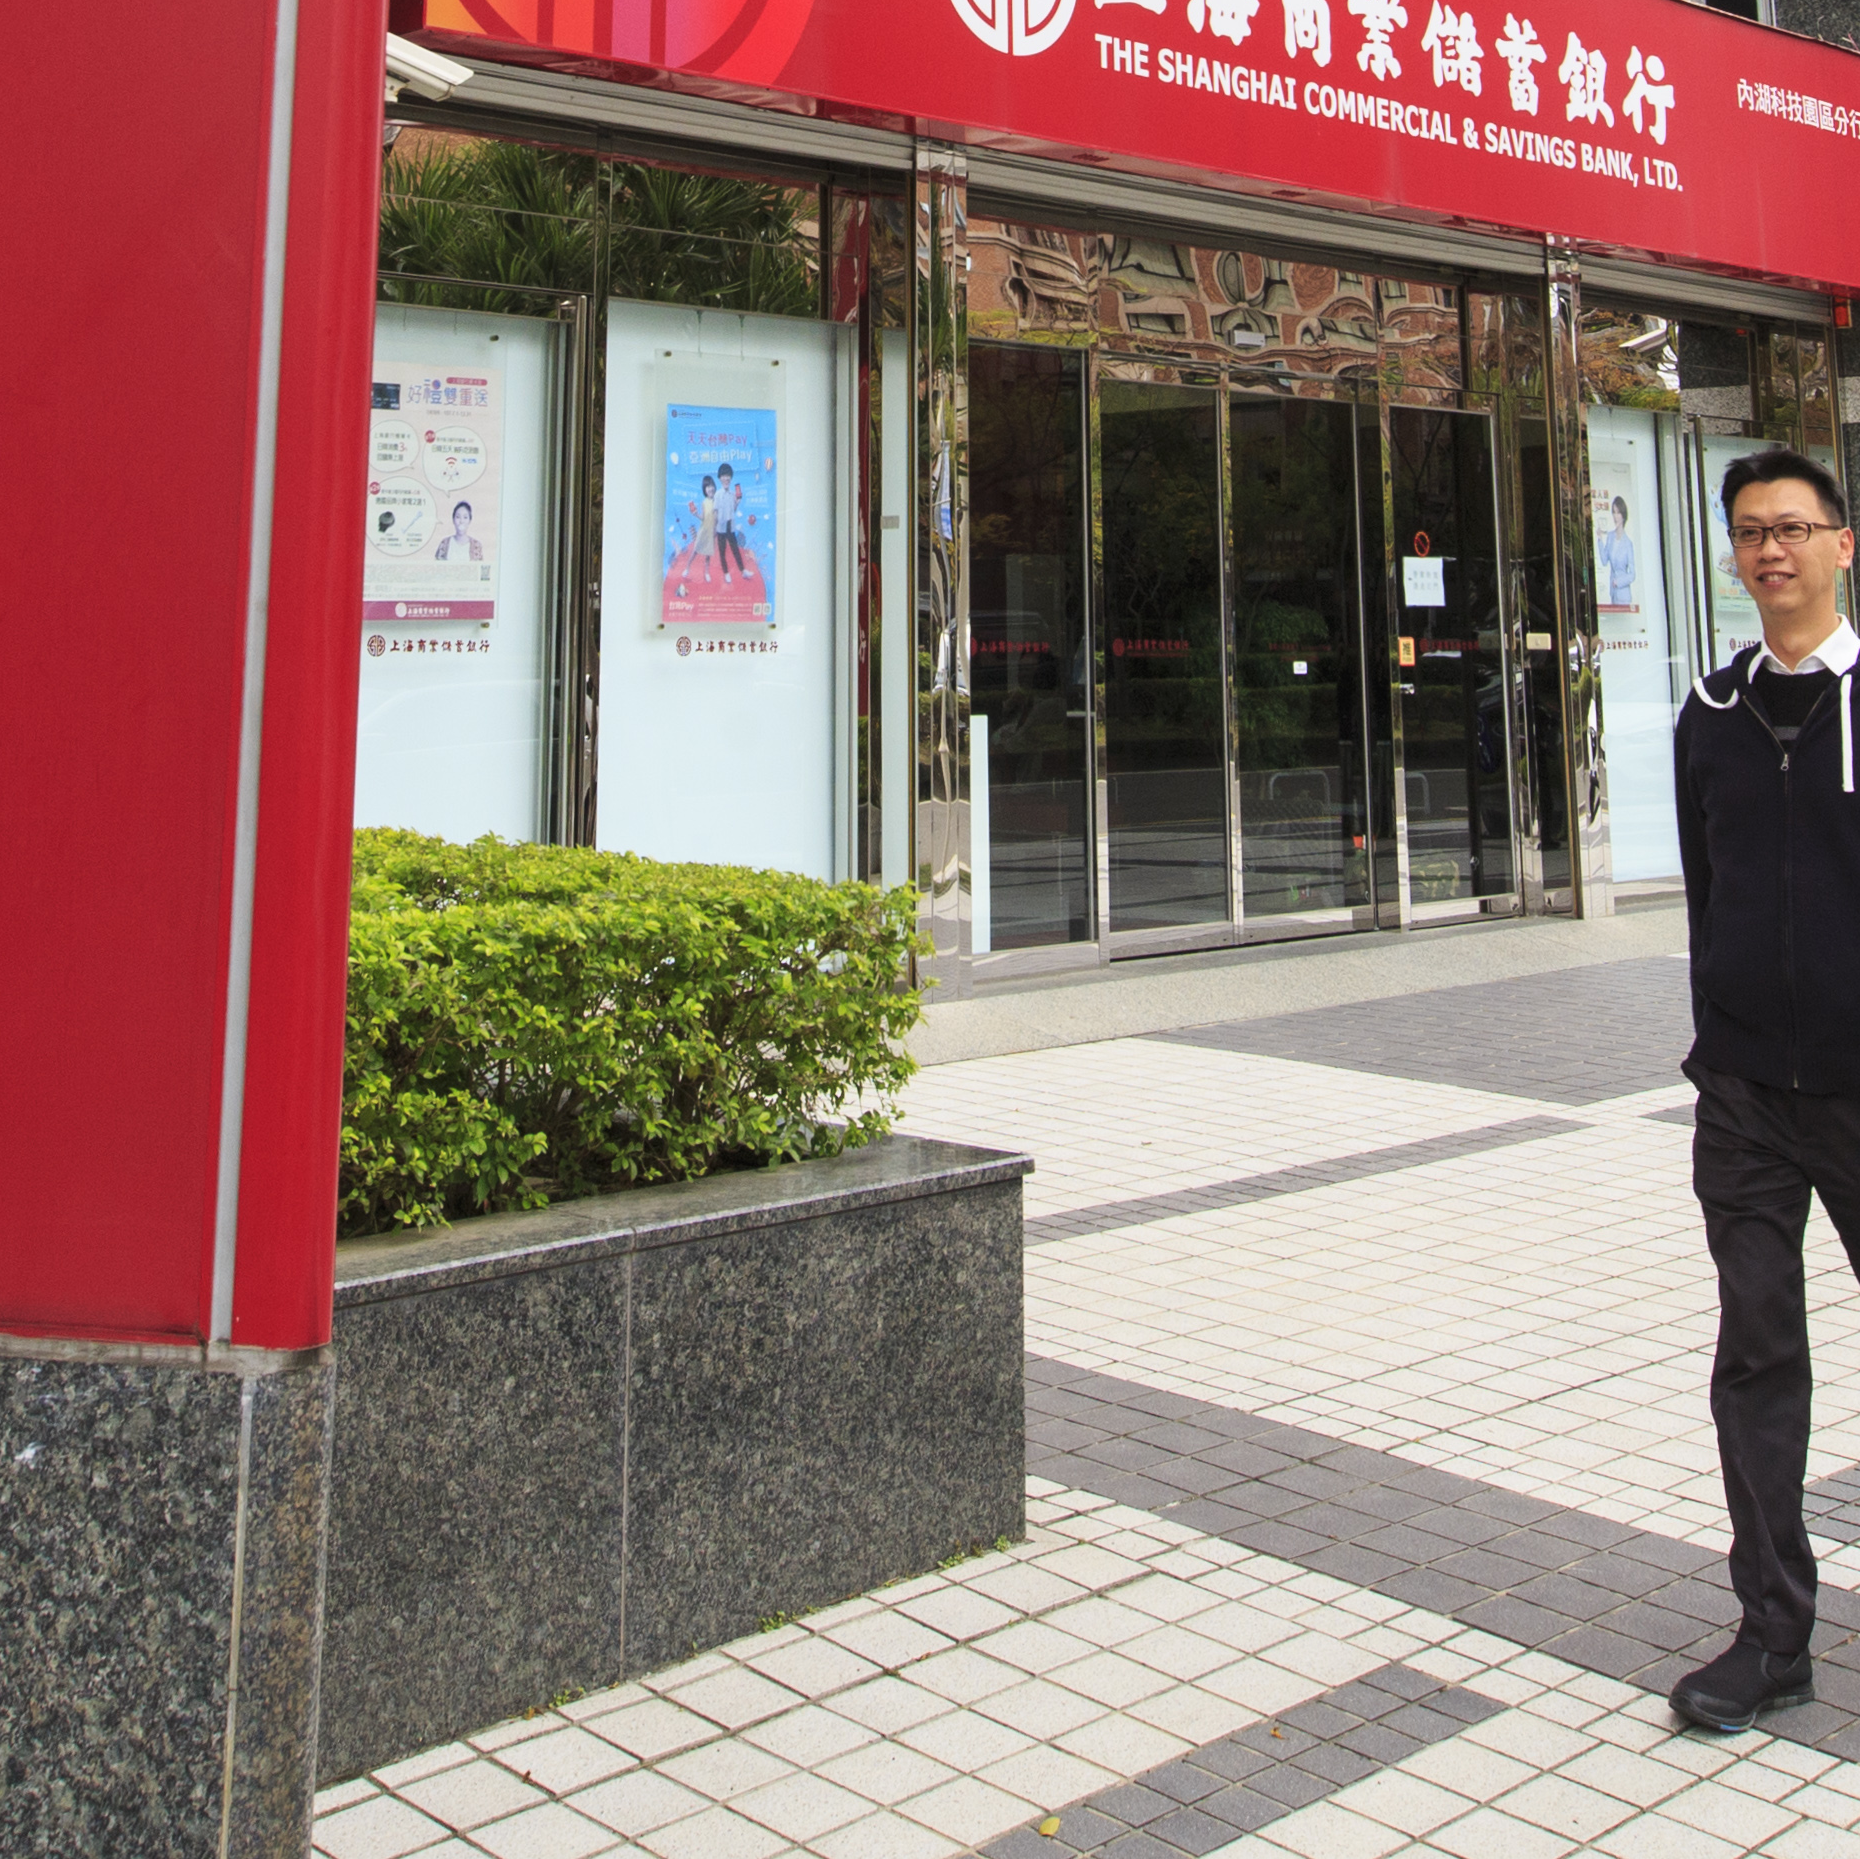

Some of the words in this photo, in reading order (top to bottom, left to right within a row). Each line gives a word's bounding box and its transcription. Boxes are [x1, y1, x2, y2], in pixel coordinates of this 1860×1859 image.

[1094, 33, 1150, 78] THE
[1158, 48, 1297, 110] SHANGHAI
[1304, 81, 1458, 145] COMMERCIAL
[1463, 117, 1481, 150] &
[1484, 122, 1577, 169] SAVINGS
[1580, 142, 1643, 188] BANK,
[1643, 156, 1683, 192] LTD.
